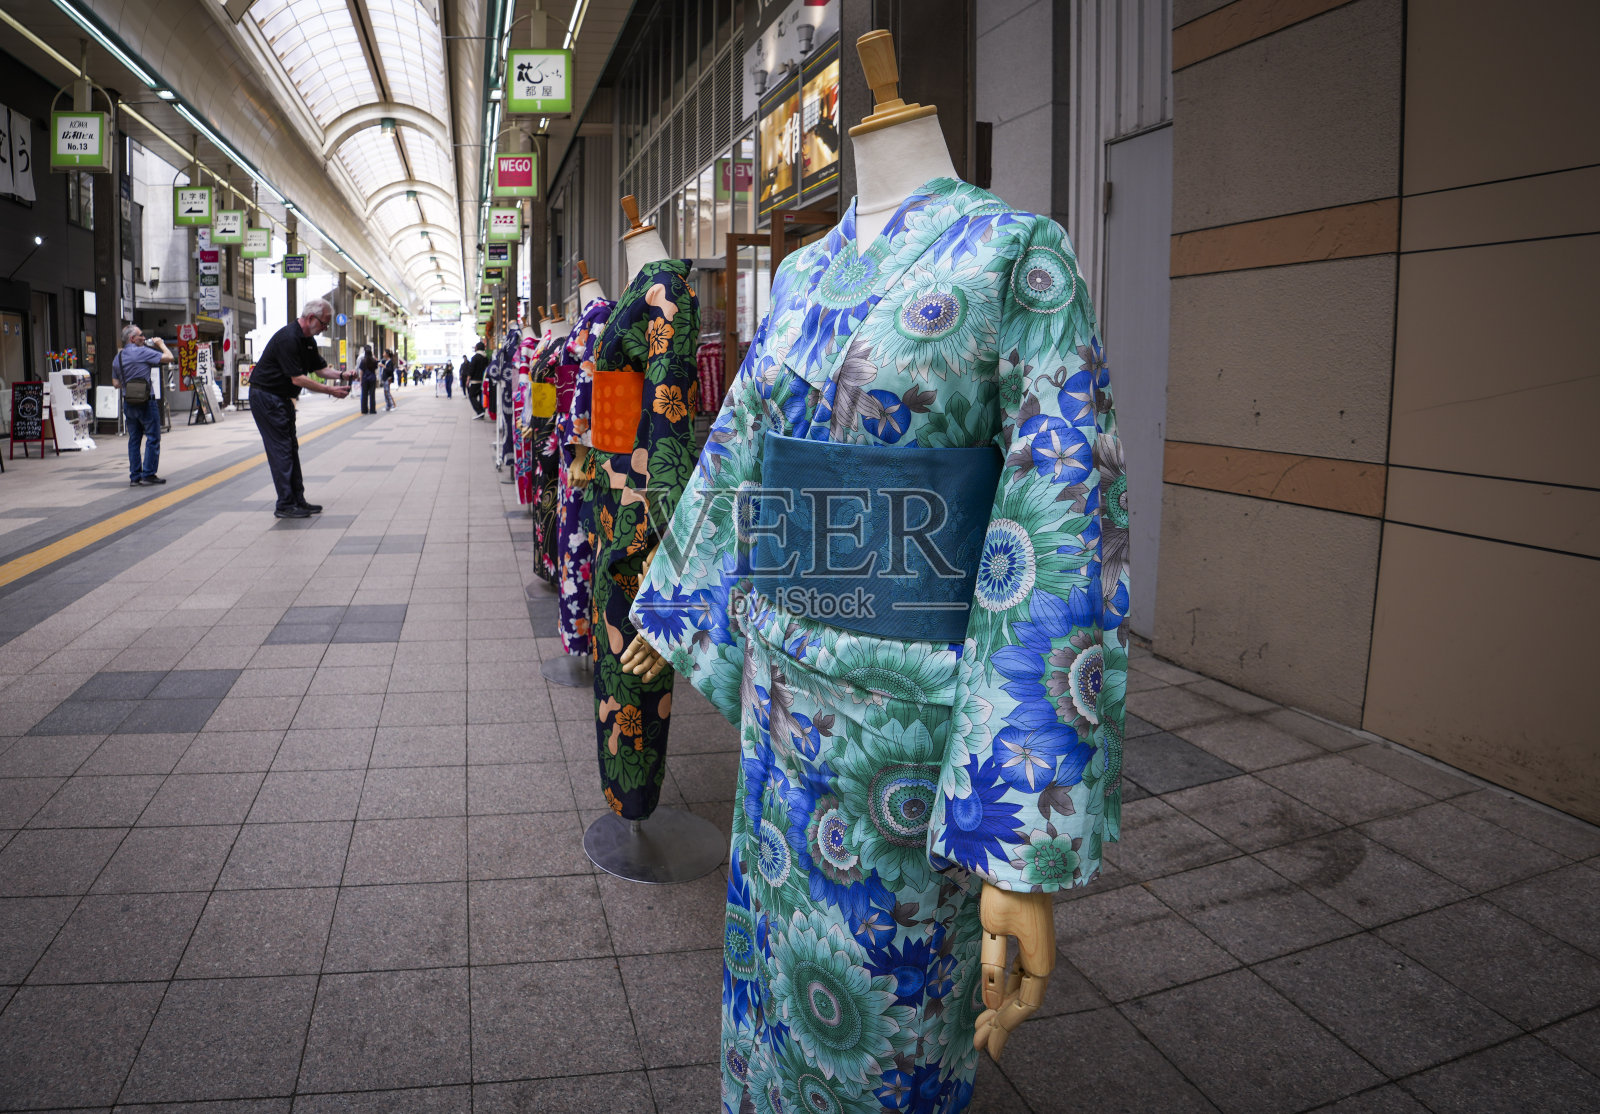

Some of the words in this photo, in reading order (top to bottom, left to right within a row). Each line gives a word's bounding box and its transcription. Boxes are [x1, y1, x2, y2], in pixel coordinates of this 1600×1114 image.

[535, 100, 542, 110] 1
[67, 143, 88, 151] No.13
[74, 155, 80, 164] 1
[500, 159, 531, 172] WEGO
